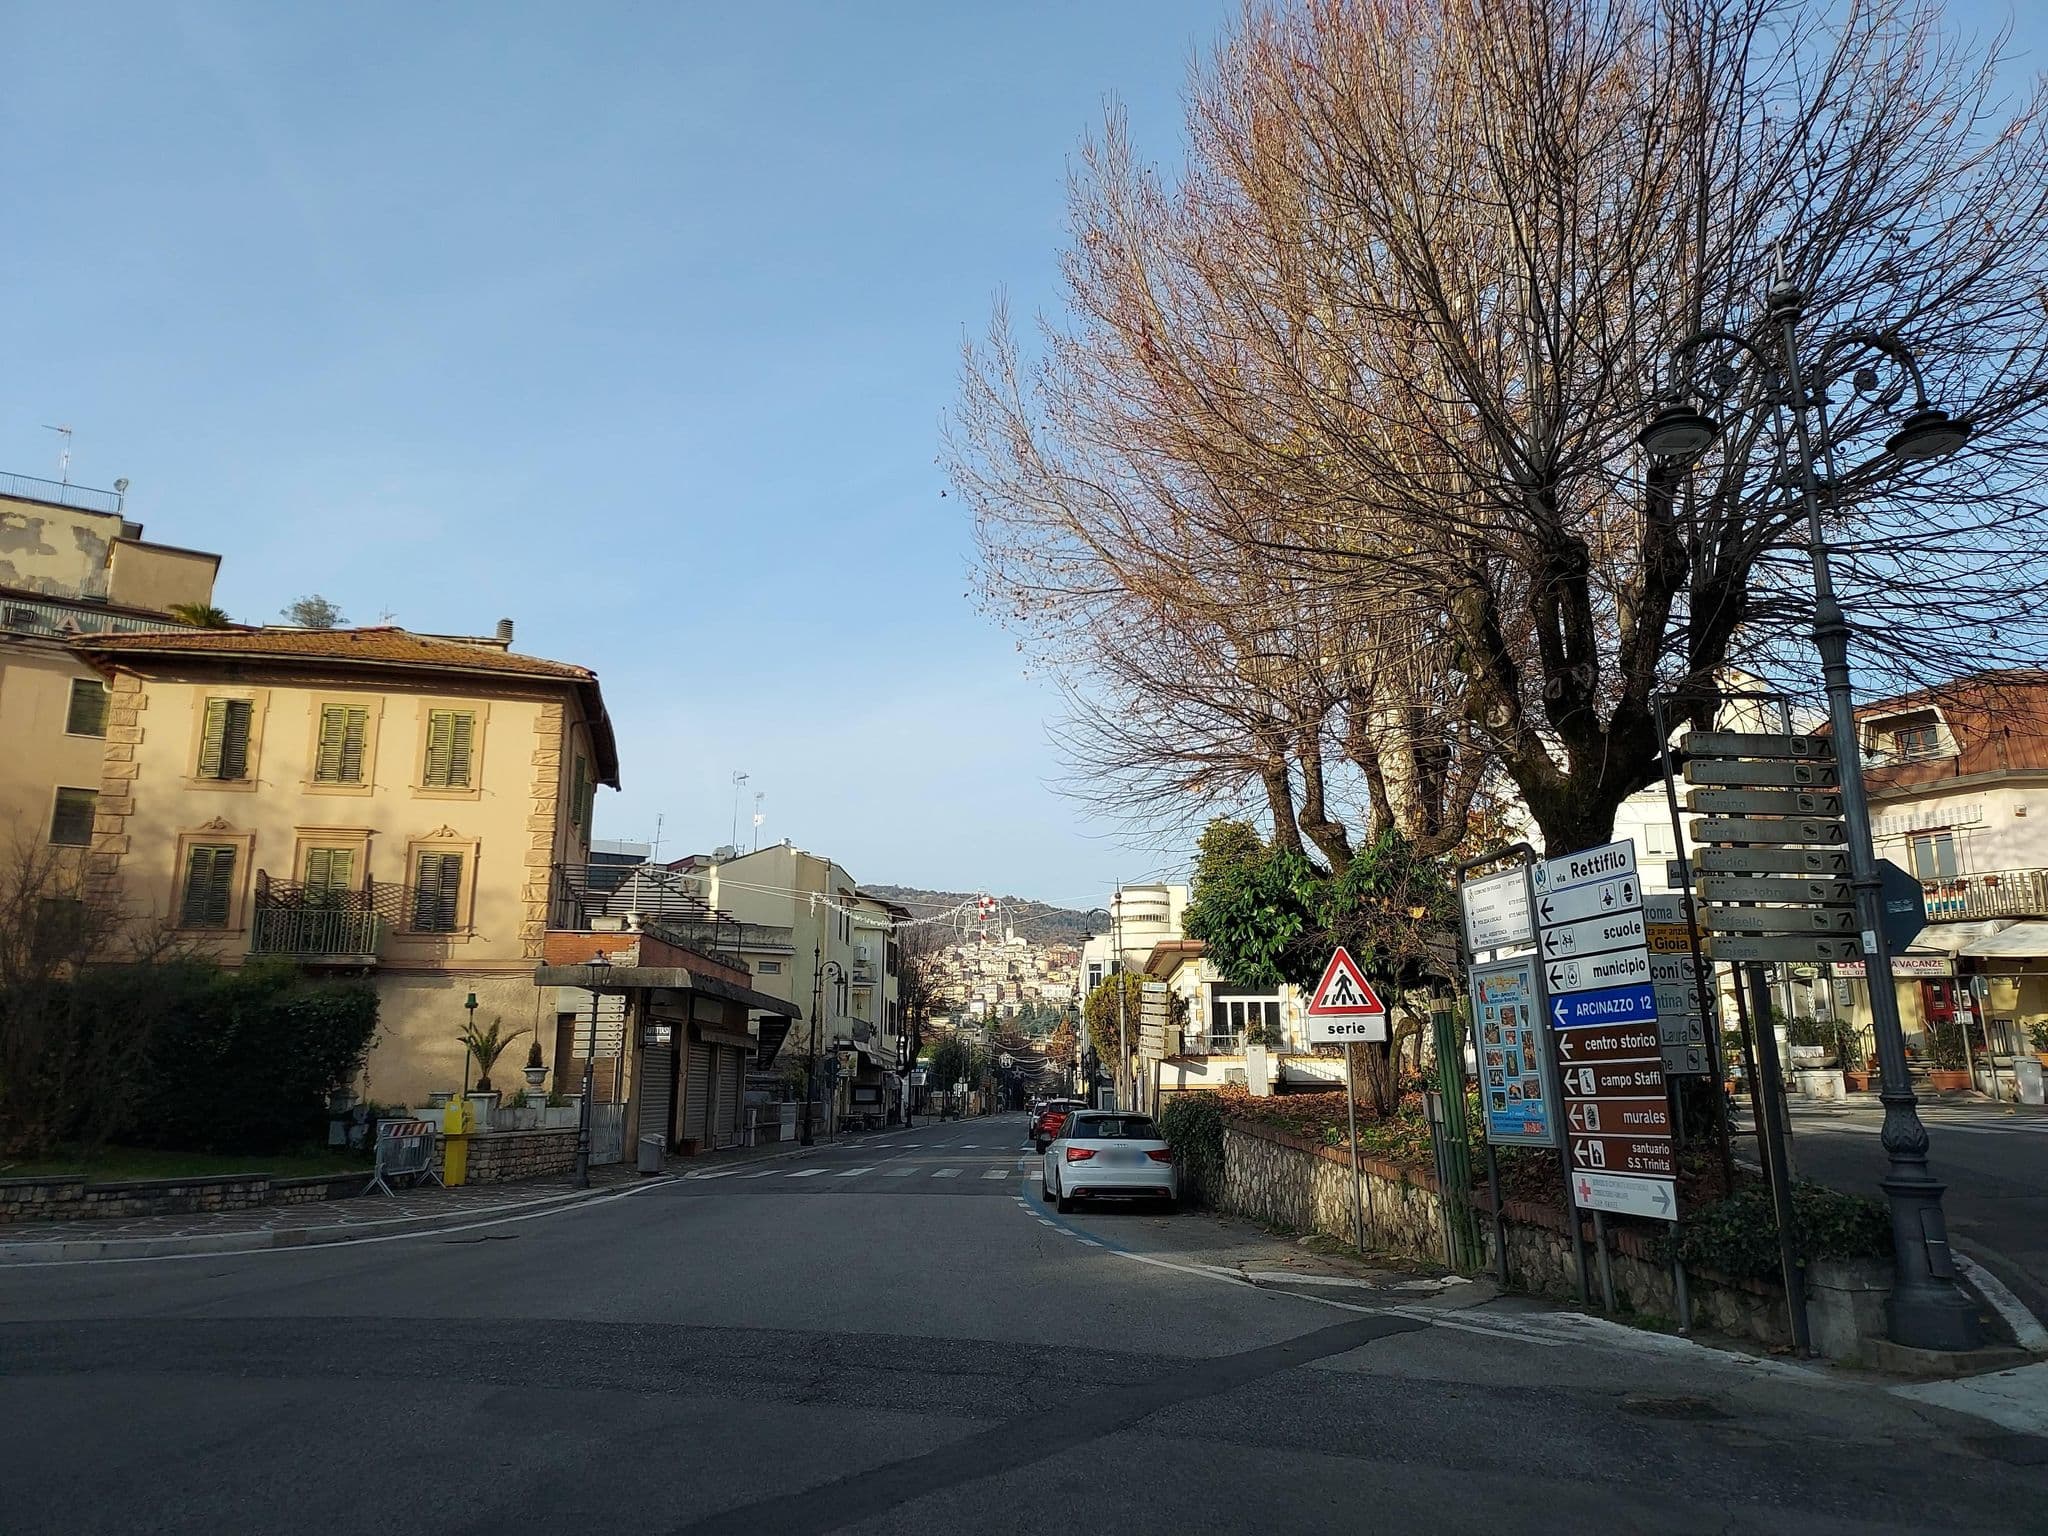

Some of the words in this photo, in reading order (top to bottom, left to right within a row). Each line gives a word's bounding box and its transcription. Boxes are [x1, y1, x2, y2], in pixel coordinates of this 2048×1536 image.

[1556, 873, 1567, 883] via
[1570, 851, 1626, 879] Rettifilo
[1603, 922, 1641, 939] scuole
[1655, 936, 1688, 951] Gioia
[1592, 957, 1646, 978] municipio
[1651, 962, 1679, 979] coni
[1899, 960, 1944, 968] VACANZE
[1576, 998, 1633, 1017] ARCINAZZO
[1639, 996, 1652, 1010] 12
[1327, 1022, 1366, 1034] serie
[1584, 1037, 1617, 1051] centro
[1620, 1034, 1656, 1049] storico
[1601, 1075, 1632, 1088] campo
[1623, 1109, 1666, 1125] murales
[1631, 1142, 1670, 1155] santuario
